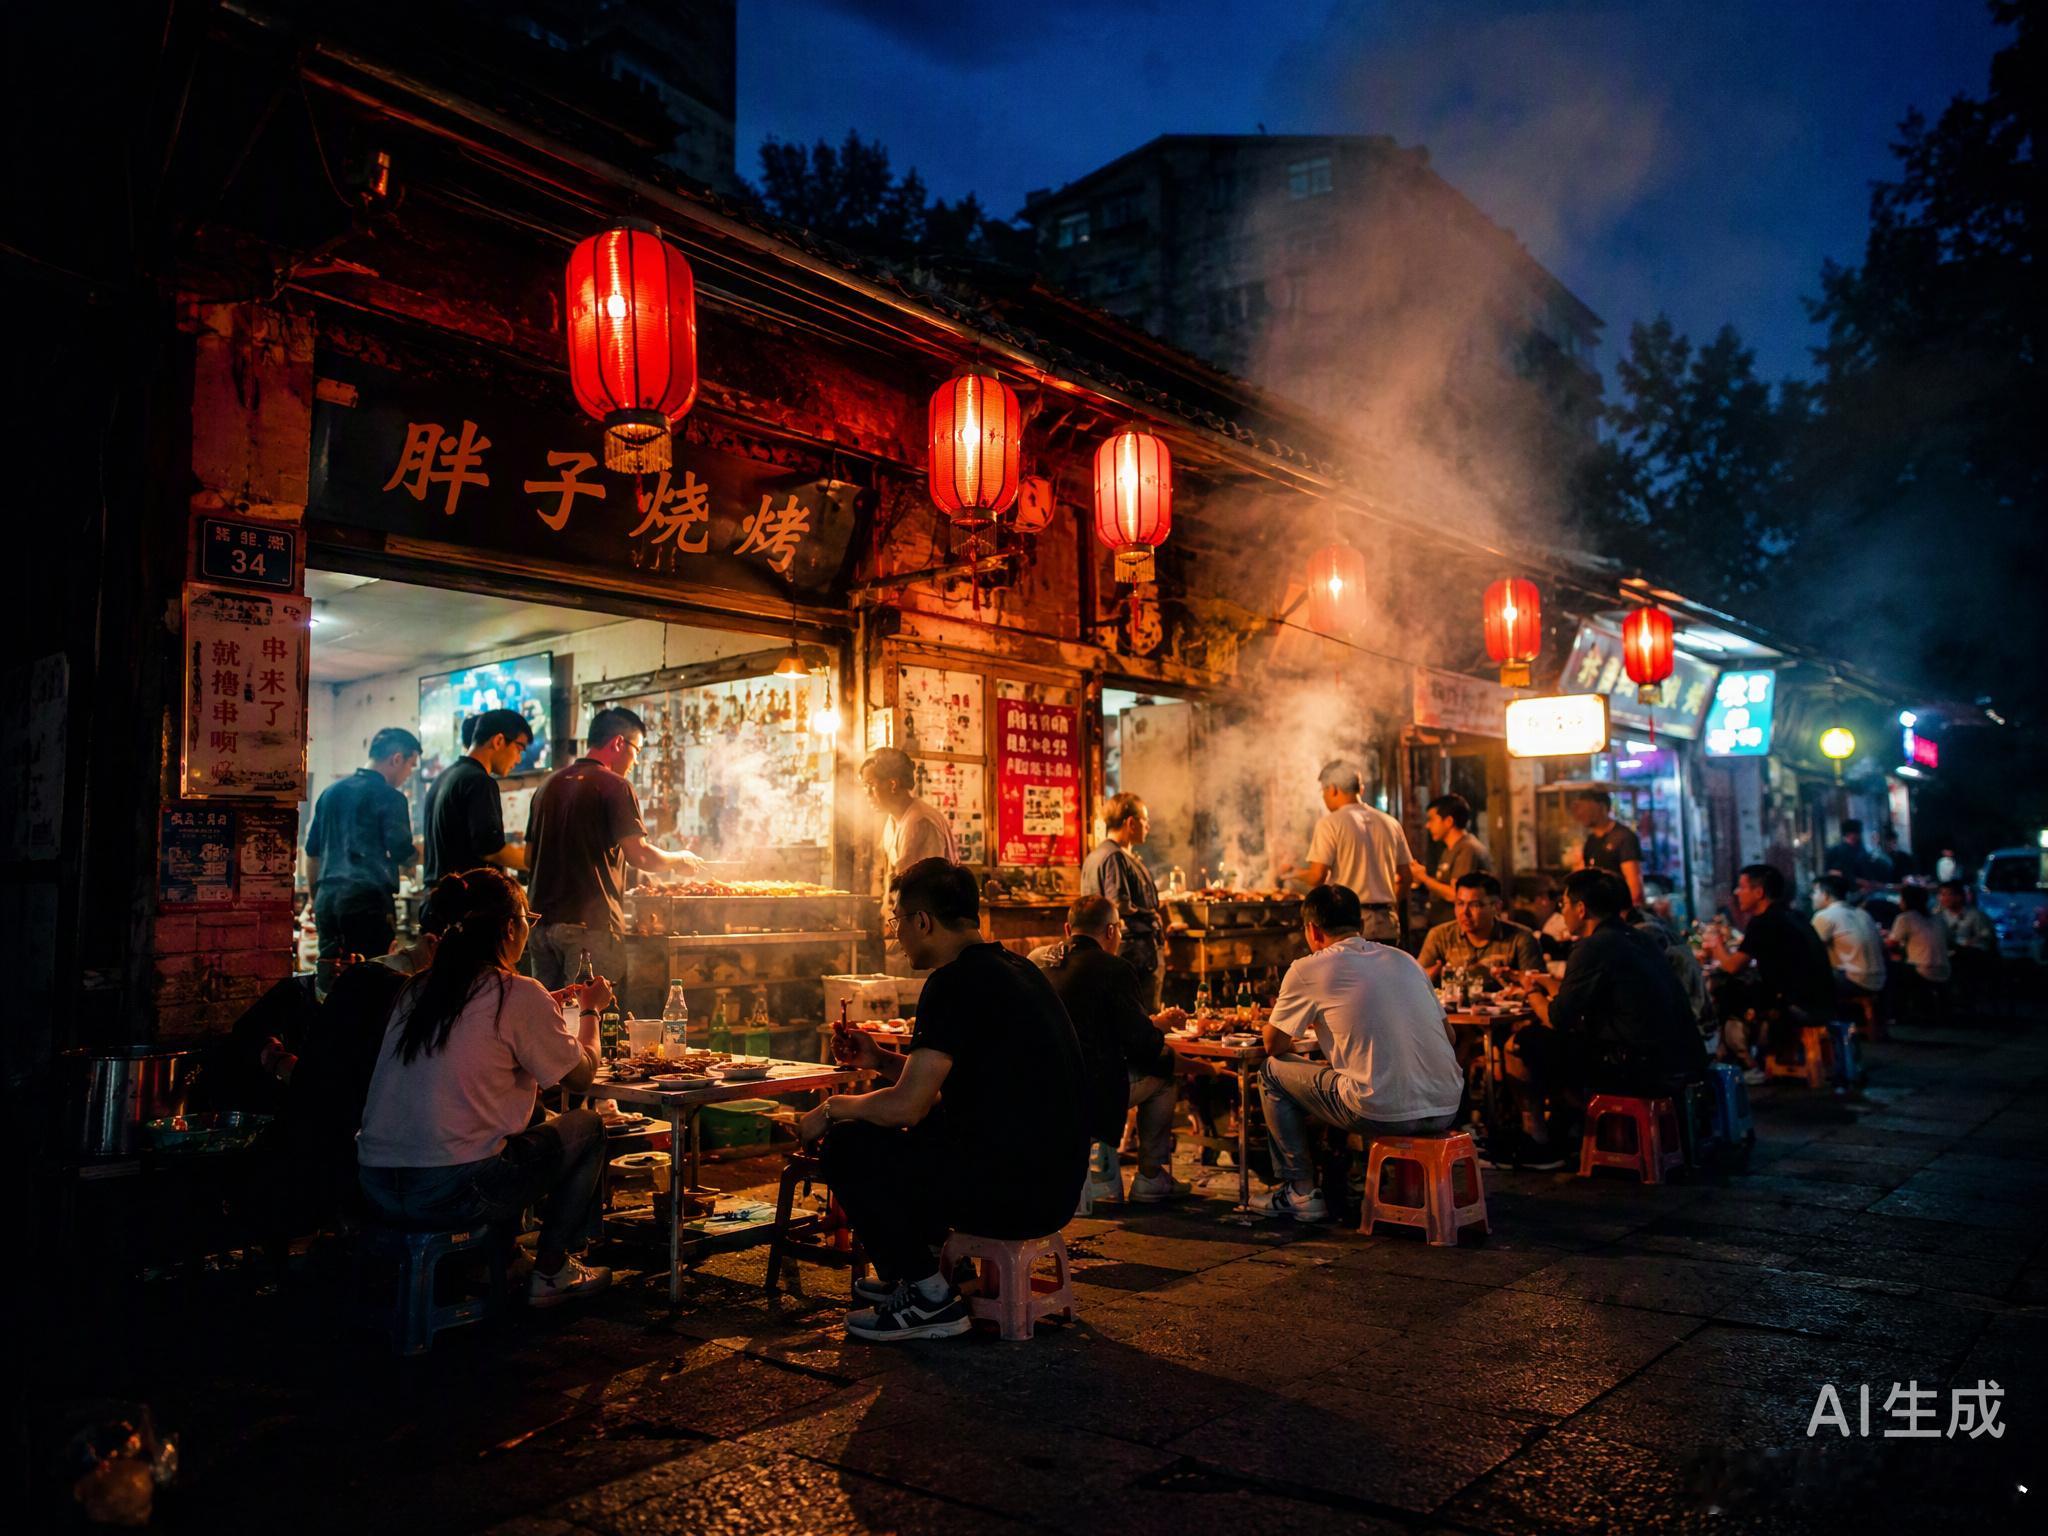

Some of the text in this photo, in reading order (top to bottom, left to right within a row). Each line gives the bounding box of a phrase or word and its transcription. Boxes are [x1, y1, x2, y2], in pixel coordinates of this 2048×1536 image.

[382, 420, 811, 575] 胖子烧烤
[231, 549, 266, 577] 34
[258, 636, 288, 727] 串来了
